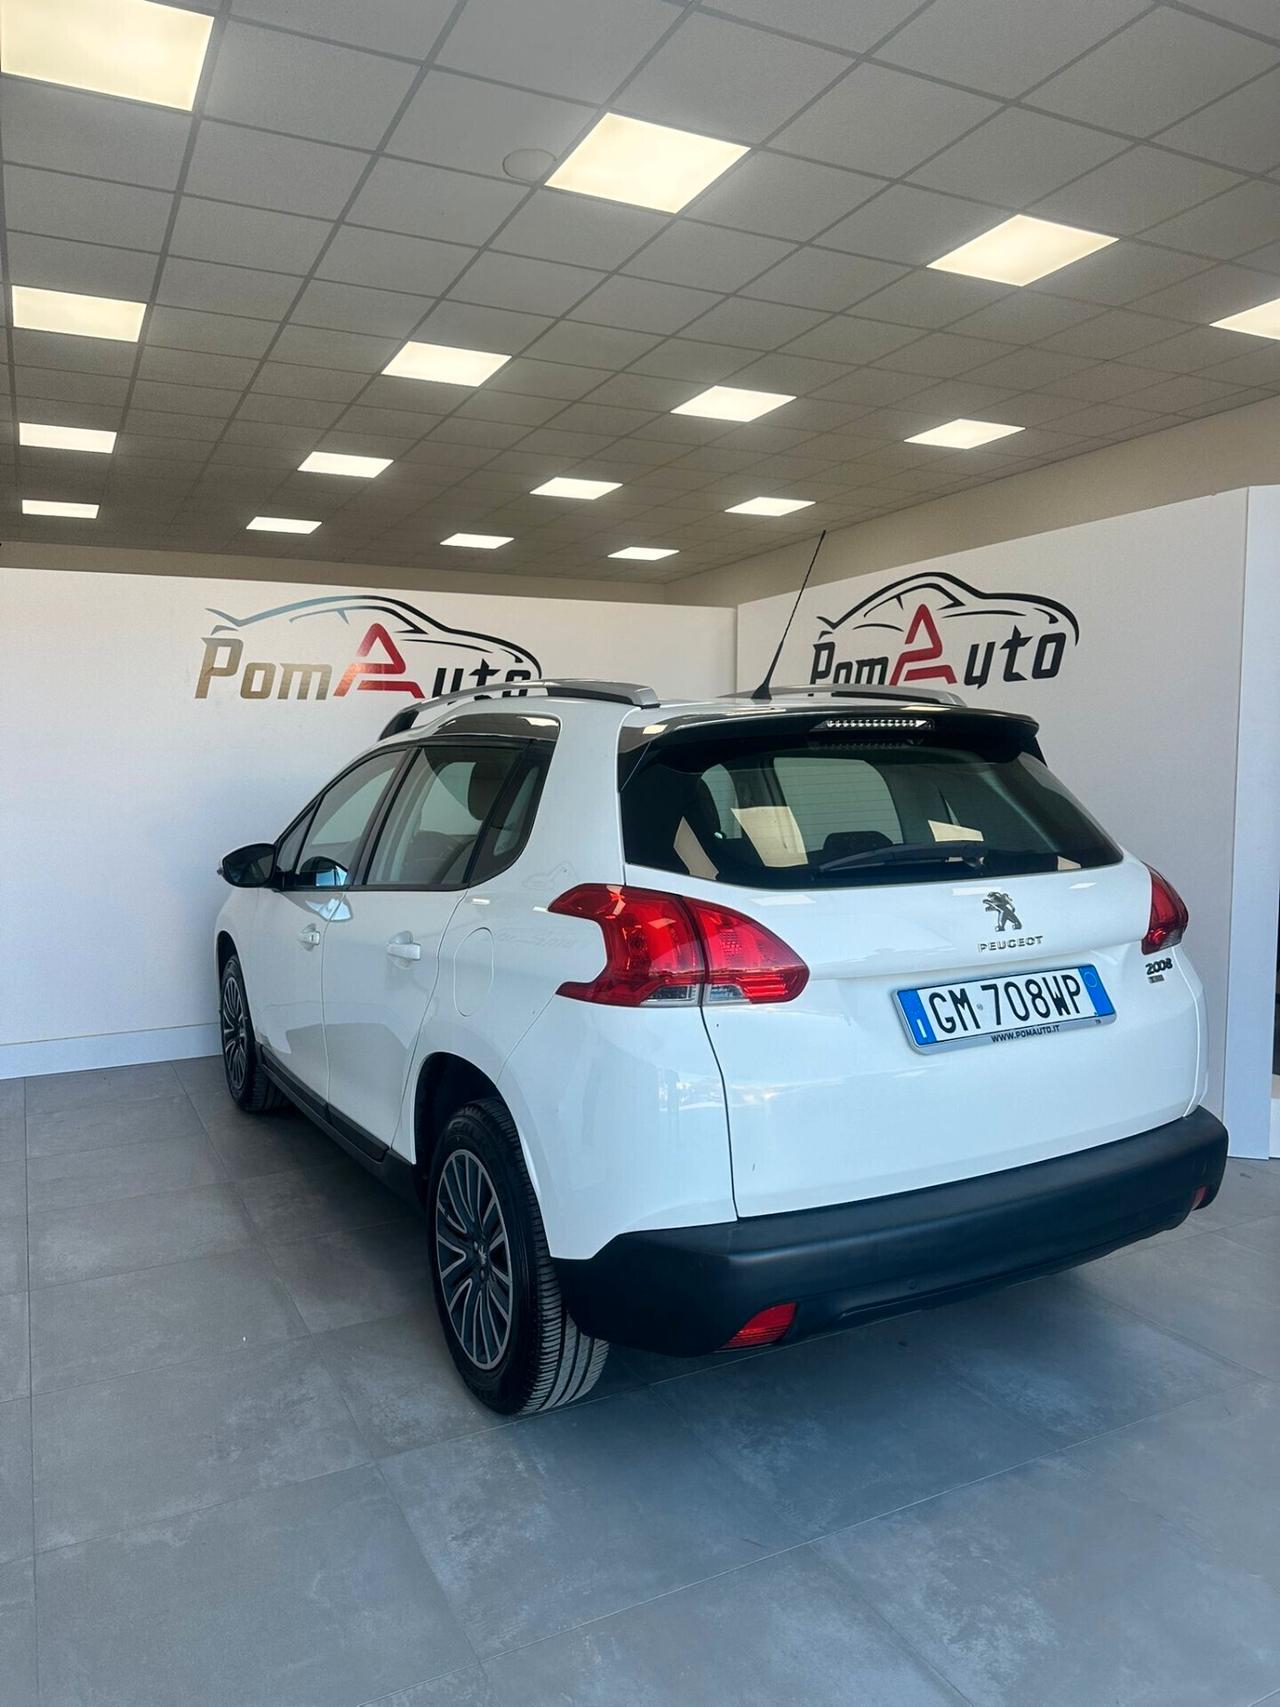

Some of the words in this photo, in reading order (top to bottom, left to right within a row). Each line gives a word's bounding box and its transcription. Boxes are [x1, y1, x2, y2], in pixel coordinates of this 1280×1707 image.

[978, 935, 1043, 952] PEUGEOT
[1145, 957, 1173, 975] 2008
[990, 1025, 1060, 1043] WWW.POMAUTO.IT
